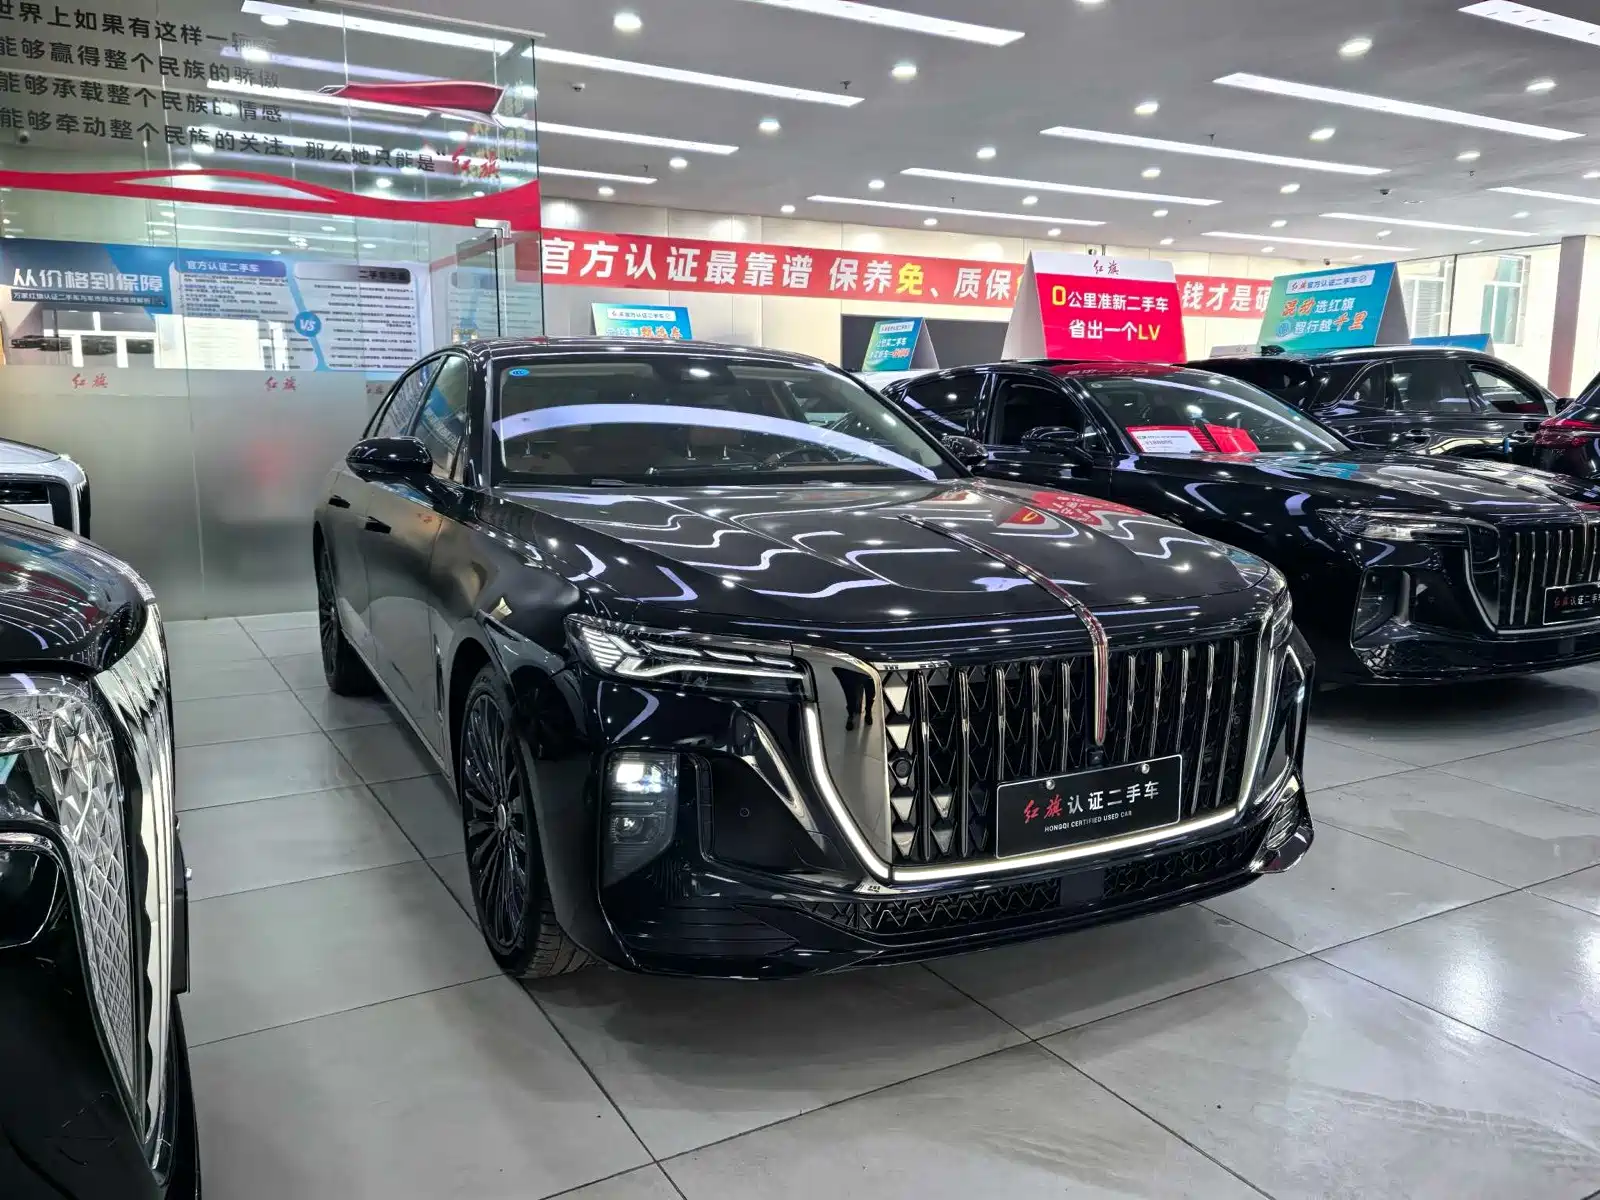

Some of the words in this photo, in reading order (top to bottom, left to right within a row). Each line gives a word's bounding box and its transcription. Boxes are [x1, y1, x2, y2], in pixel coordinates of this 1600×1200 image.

[186, 260, 261, 273] 官方认证二手车
[541, 235, 813, 290] 官方认证最靠谱
[829, 257, 1024, 301] 保养免、质保
[1092, 259, 1119, 275] 红旗
[13, 267, 164, 293] 从价格到保障
[1052, 285, 1170, 313] 0公里准新二手车
[300, 319, 316, 332] VS
[1068, 319, 1160, 341] 省出一个LV
[72, 373, 109, 390] 红旗
[1023, 781, 1160, 824] 红旗认证二手车
[1044, 822, 1070, 832] HONGQI
[1070, 816, 1102, 828] CERTIFIED
[1103, 812, 1119, 821] USED
